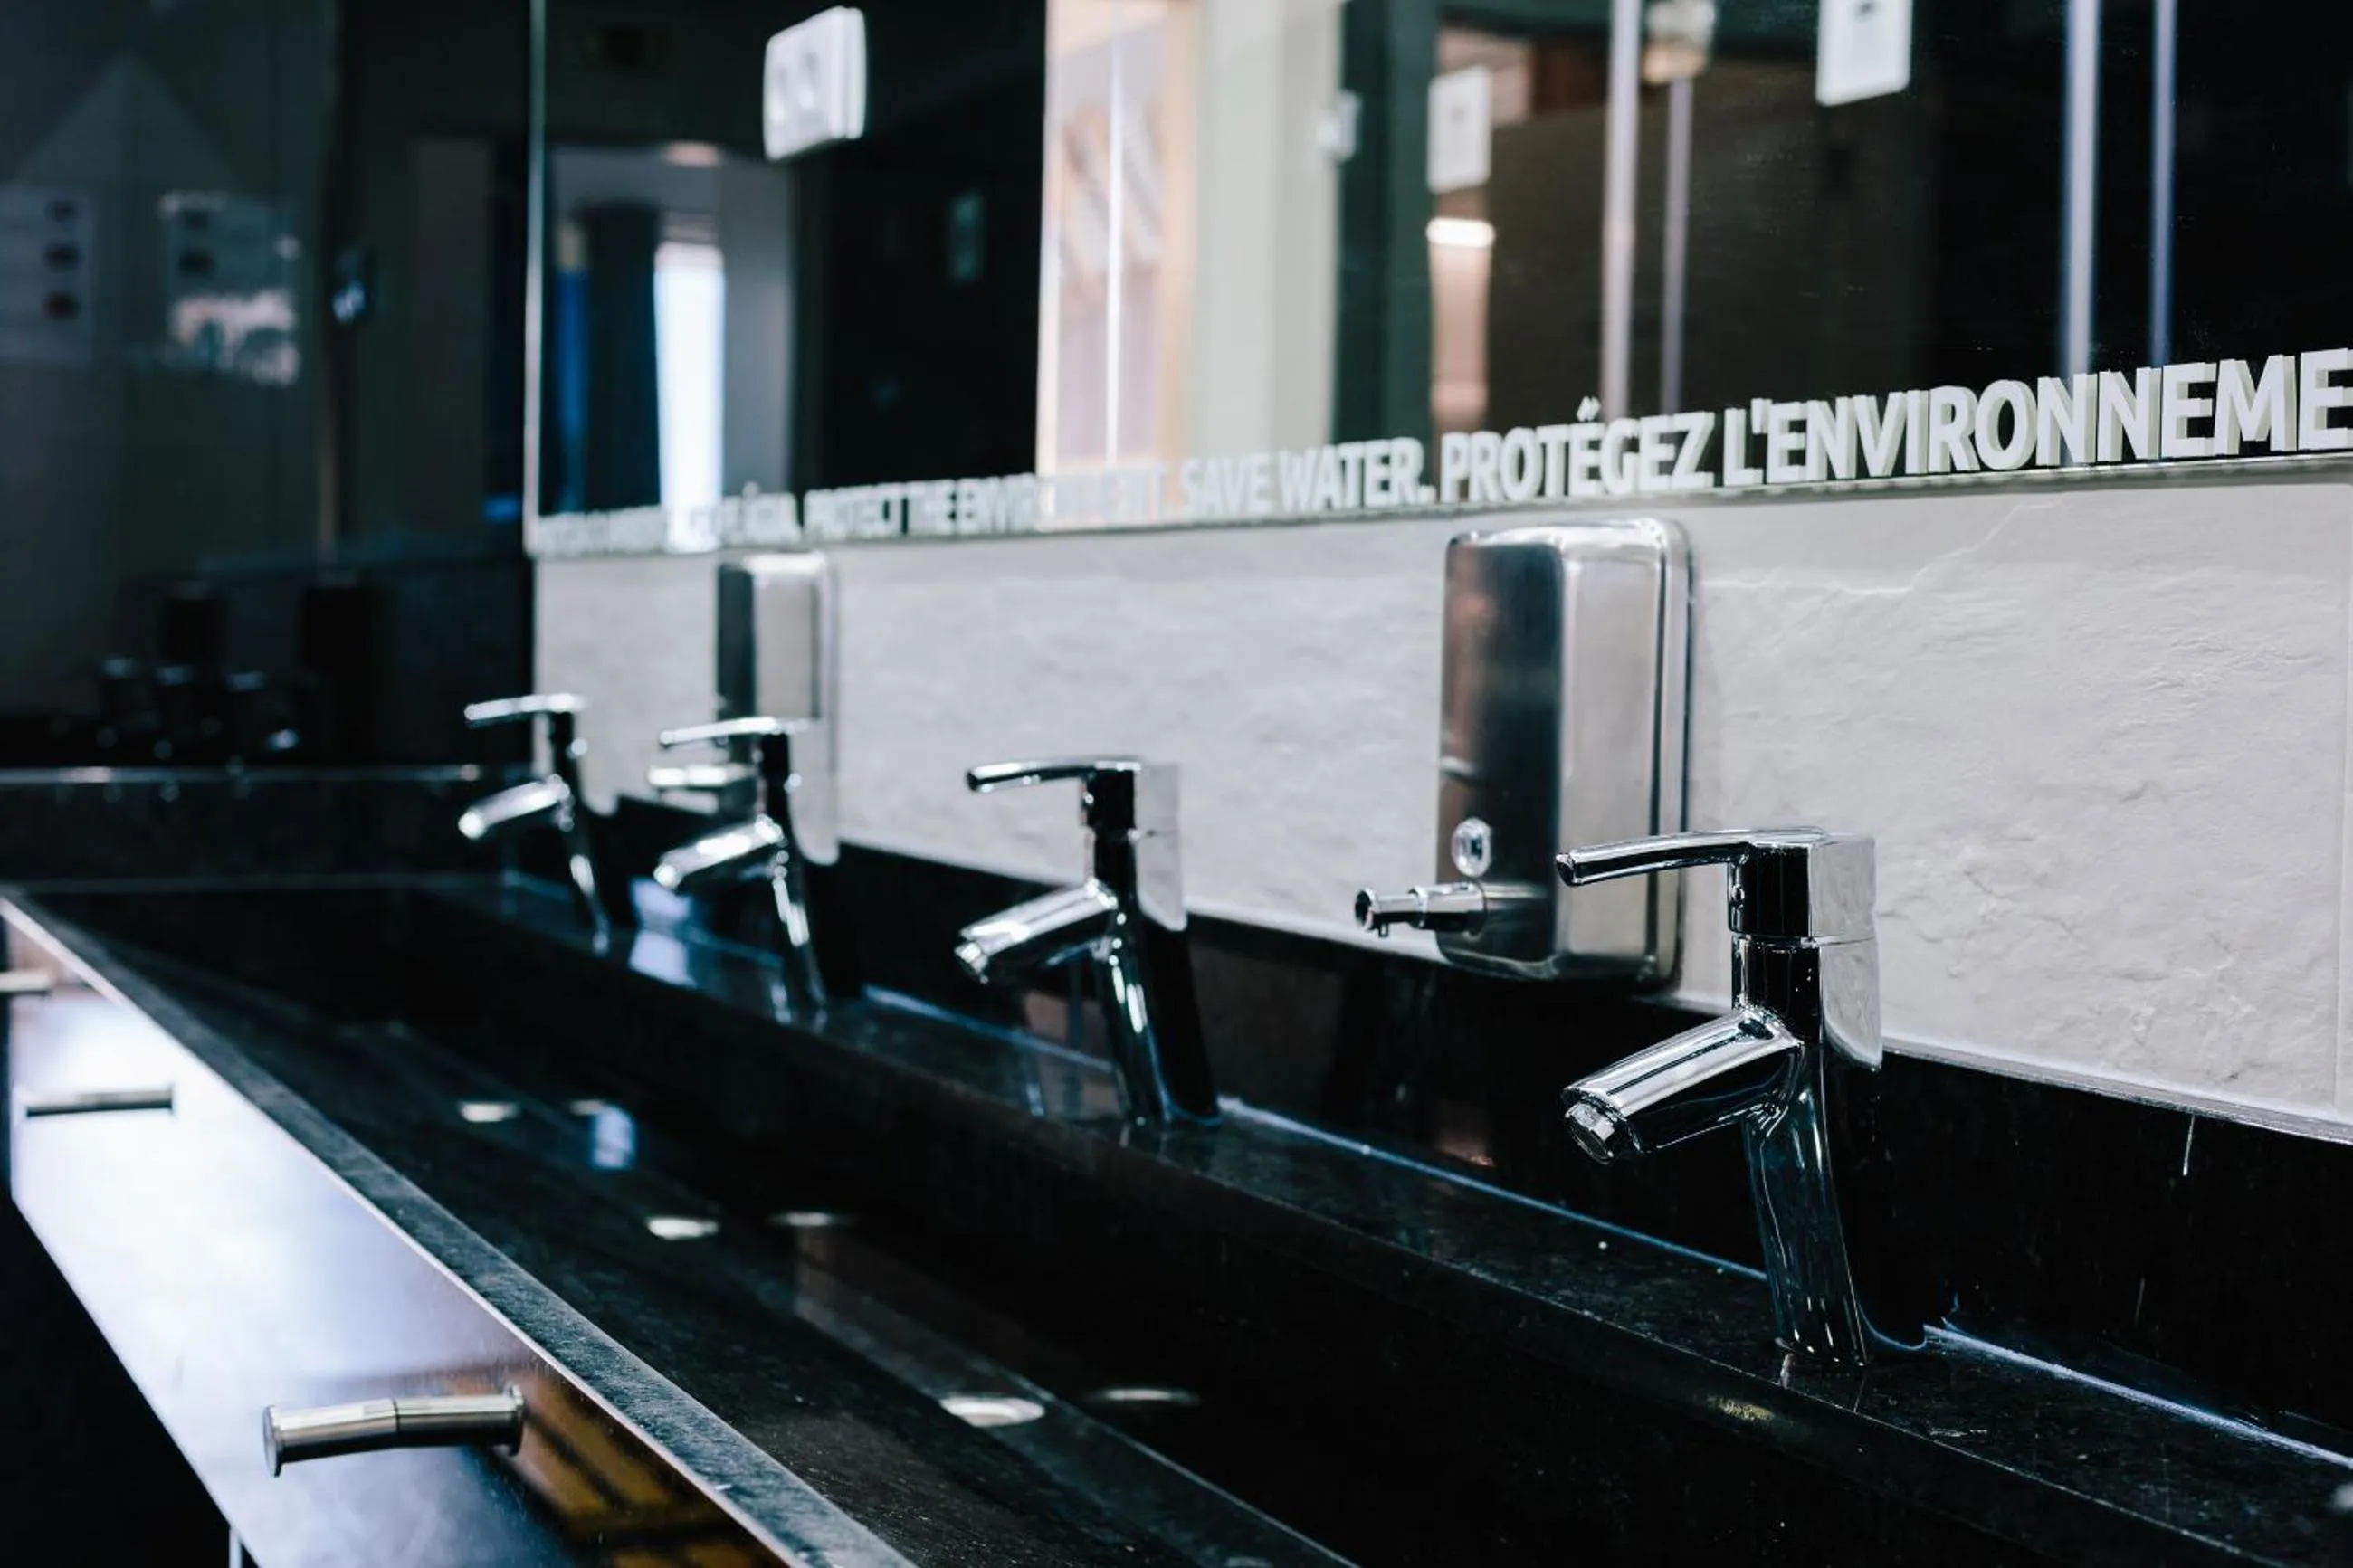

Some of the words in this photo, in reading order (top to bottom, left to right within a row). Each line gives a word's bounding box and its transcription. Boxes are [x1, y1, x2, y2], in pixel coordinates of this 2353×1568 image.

[1182, 454, 1272, 518] SAVE
[1279, 436, 1436, 512] WATER.
[1441, 395, 1715, 502] PROTÉGEZ
